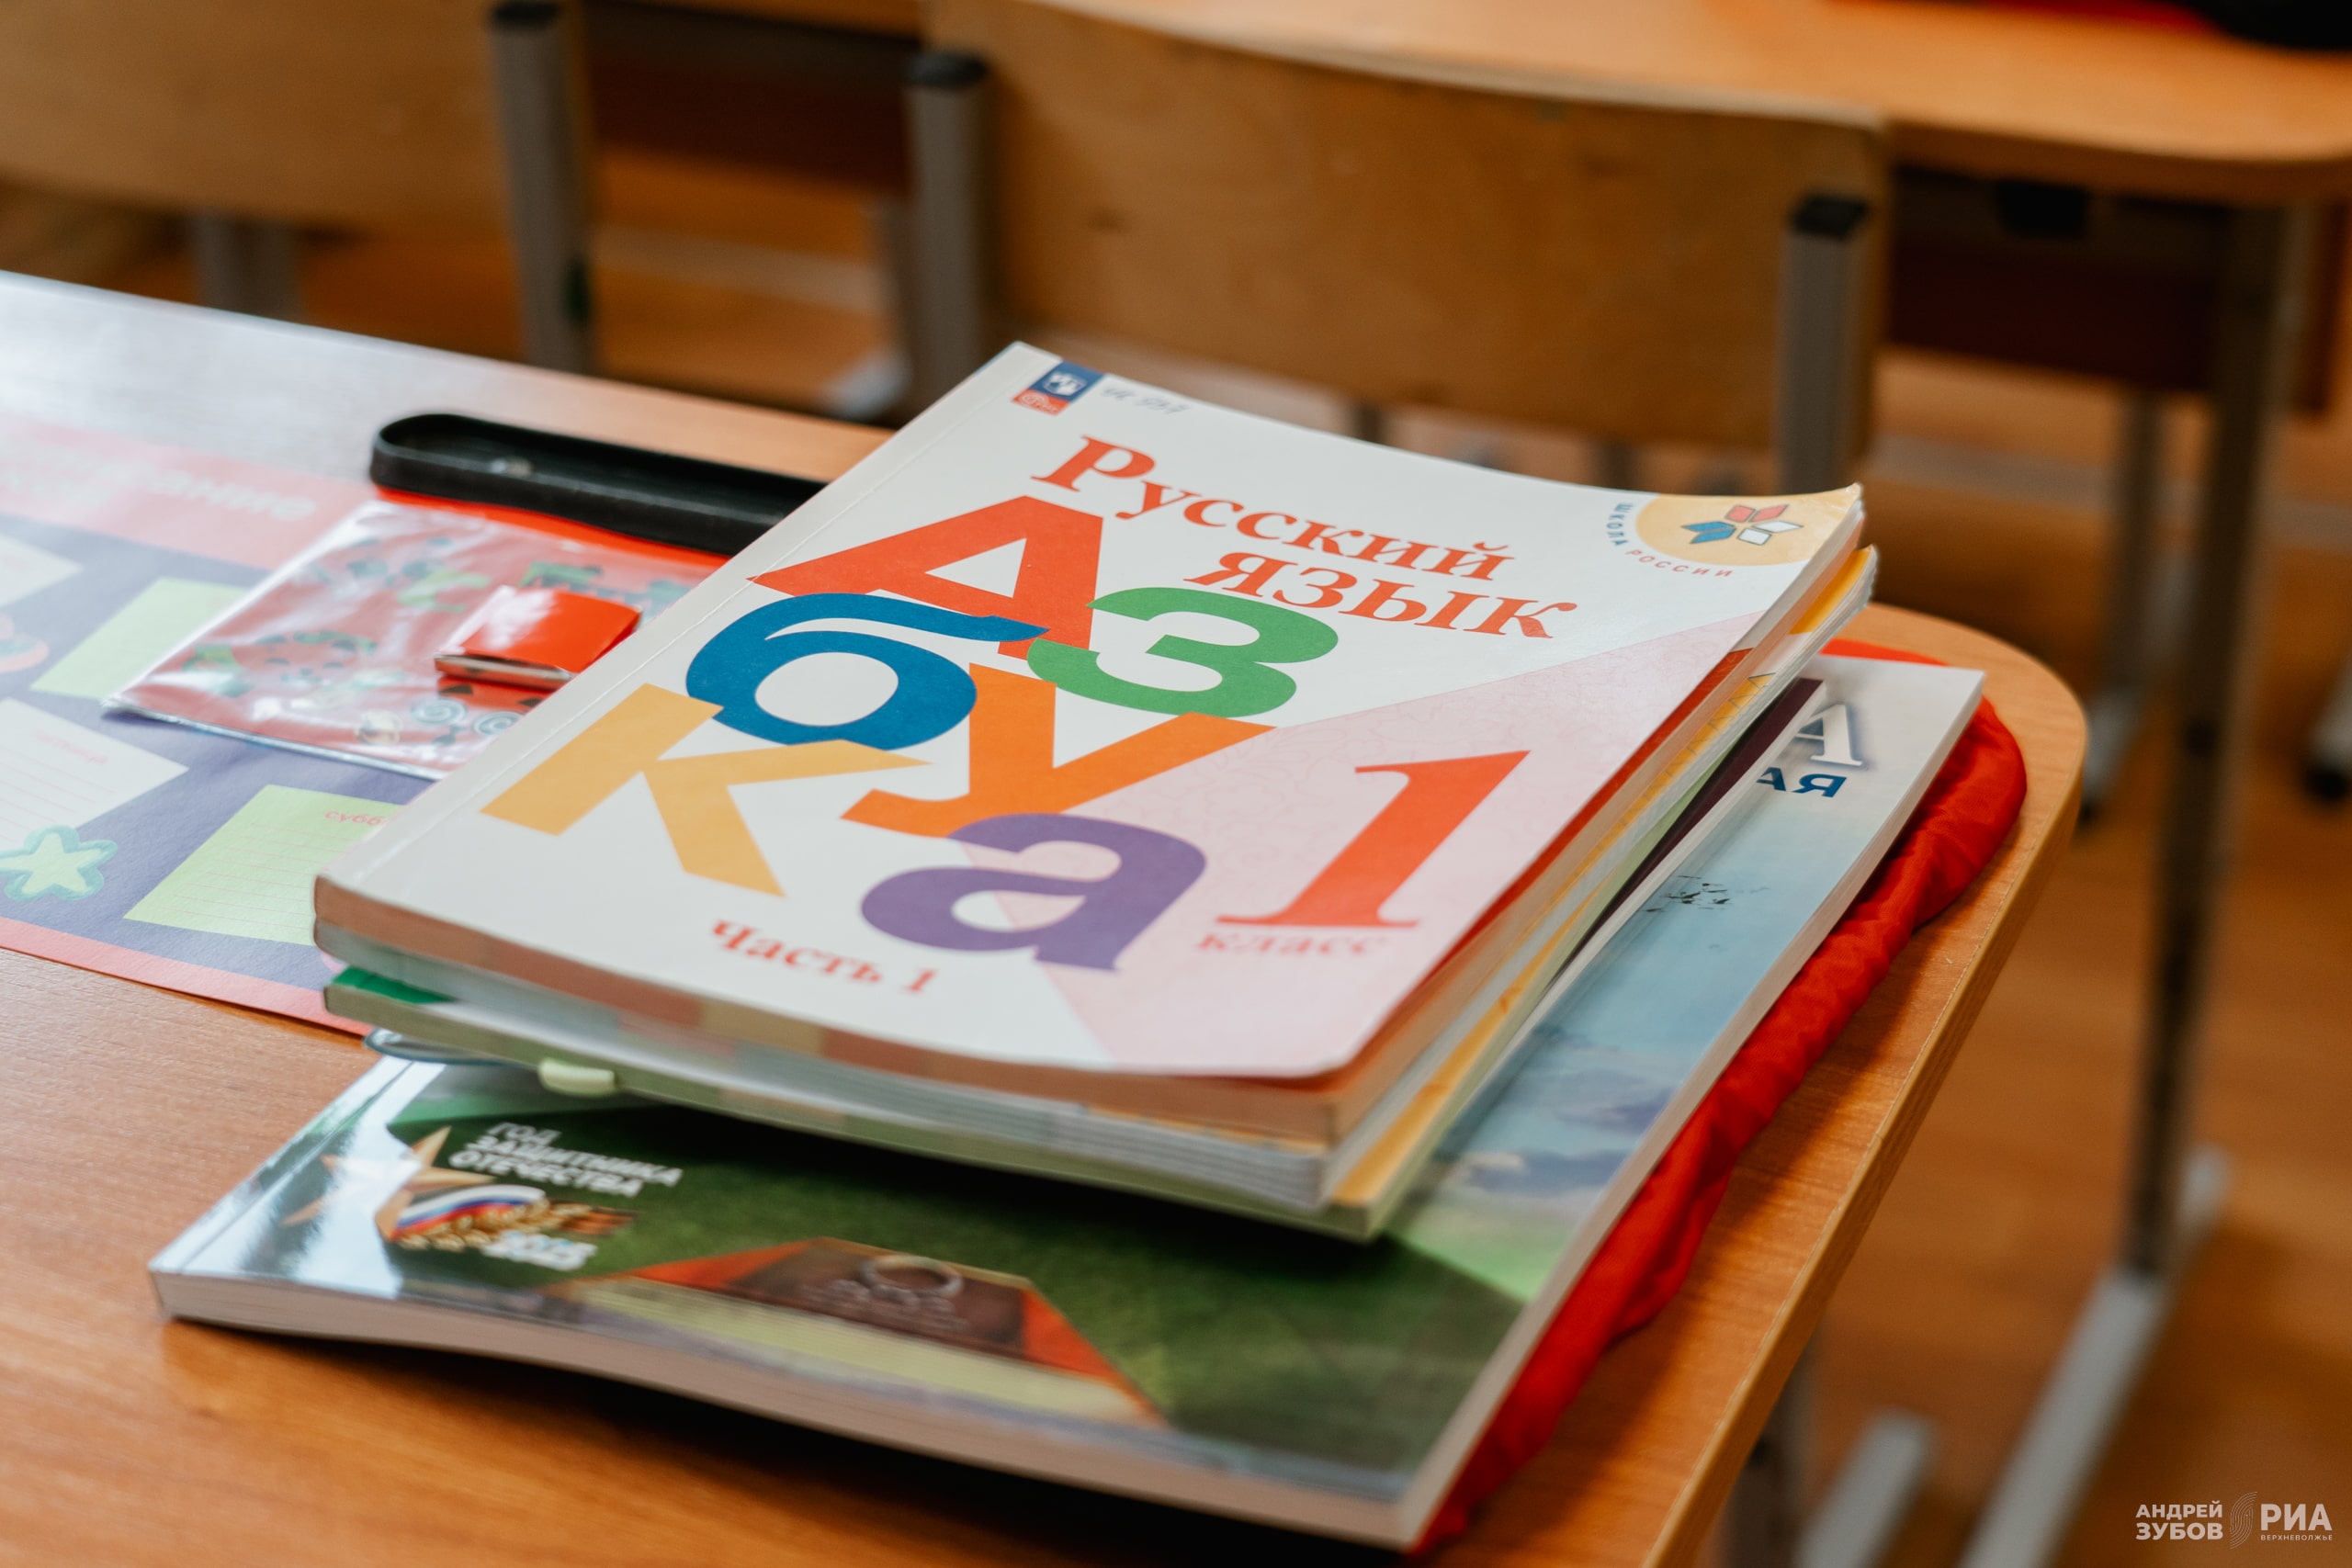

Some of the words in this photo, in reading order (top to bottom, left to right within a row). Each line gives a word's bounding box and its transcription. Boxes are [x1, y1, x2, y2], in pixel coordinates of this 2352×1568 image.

[1031, 435, 1514, 581] Русский
[1606, 502, 1633, 547] ШКОЛА
[1624, 549, 1735, 577] РОССИИ
[1217, 750, 1532, 929] 1
[1195, 931, 1389, 958] класс
[901, 967, 938, 994] 1
[486, 1122, 562, 1145] ГОД
[448, 1150, 644, 1198] ОТЕЧЕСТВА
[467, 1135, 684, 1188] ЗАЩИТНИКА
